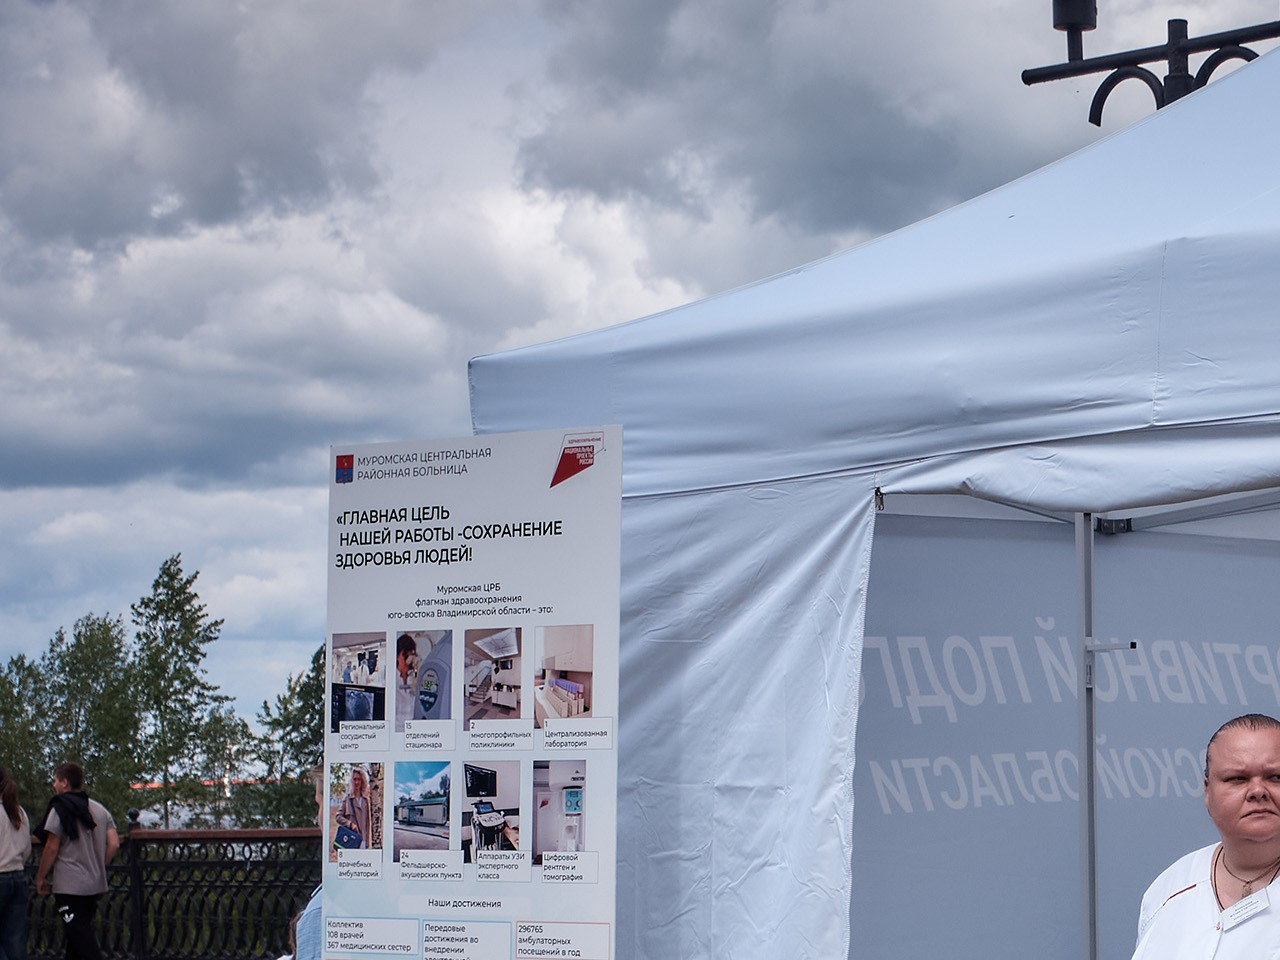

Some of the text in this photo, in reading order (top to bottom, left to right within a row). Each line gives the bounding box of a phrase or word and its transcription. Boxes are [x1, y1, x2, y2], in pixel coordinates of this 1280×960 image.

[357, 448, 492, 467] МУРОМСКАЯ ЦЕНТРАЛЬНАЯ
[357, 464, 468, 481] РАЙОННАЯ БОЛЬНИЦА
[336, 506, 450, 525] «ГЛАВНАЯ ЦЕЛЬ
[340, 521, 562, 547] НАШЕЙ РАБОТЫ -СОХРАНЕНИЕ
[335, 544, 472, 570] ЗДОРОВЬЯ ЛЮДЕЙ!
[437, 583, 501, 595] Муромская ЦРБ
[415, 594, 522, 608] флагман здравоохранения
[388, 606, 553, 620] юго-востока Владимирской области это:
[341, 723, 385, 731] Региональный
[341, 733, 376, 741] сосудистый
[471, 731, 531, 739] многопрофильных
[545, 730, 608, 738] Централизованная
[545, 740, 587, 748] лаборатория
[478, 853, 511, 861] Аппараты
[544, 853, 578, 861] Цифровой
[401, 861, 448, 869] Фельдшерско-
[339, 870, 379, 878] амбулаторий
[544, 873, 583, 881] томография
[428, 899, 501, 909] Наши достижения
[327, 921, 364, 929] Коллектив
[424, 924, 466, 932] Передовые
[518, 925, 543, 933] 296765
[327, 931, 339, 939] 108
[518, 936, 571, 946] амбулаторных
[327, 941, 412, 952] 367 медицинских сестер
[424, 946, 465, 954] внедрении
[518, 948, 560, 956] посещений
